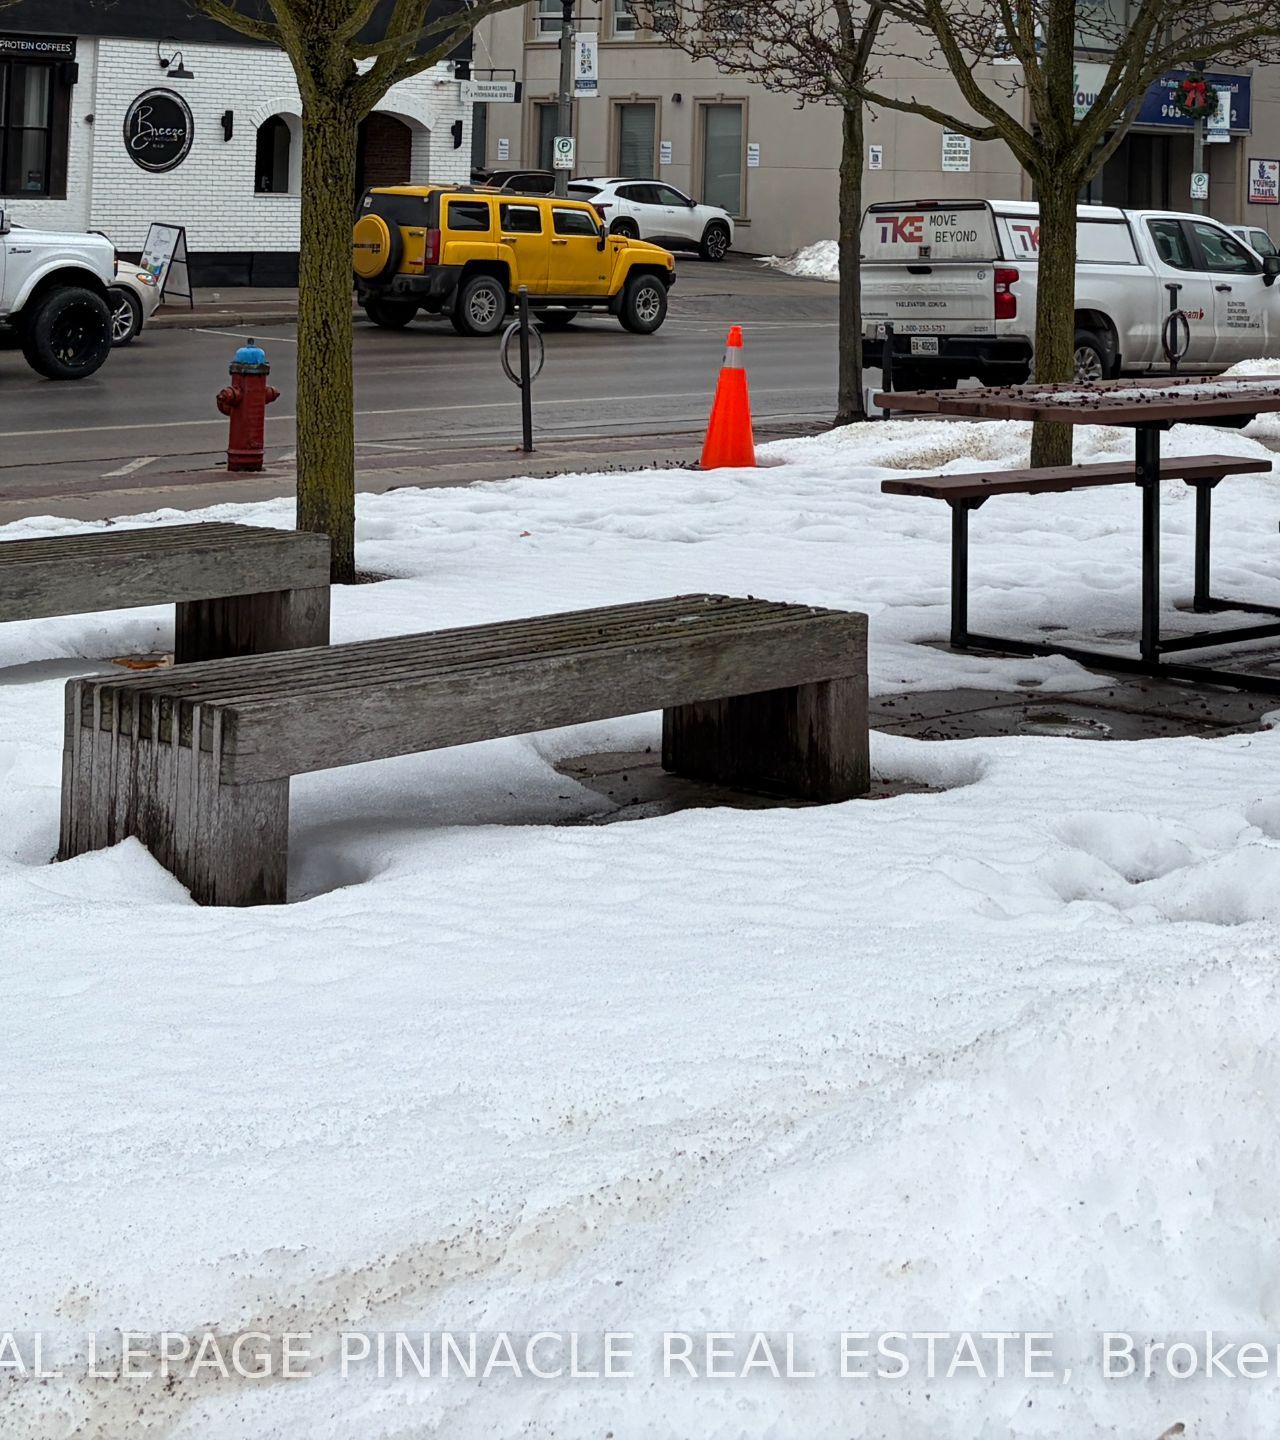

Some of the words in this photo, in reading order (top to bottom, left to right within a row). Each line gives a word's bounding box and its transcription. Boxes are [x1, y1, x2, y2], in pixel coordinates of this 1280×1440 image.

[0, 40, 35, 50] PROTEIN
[35, 42, 72, 53] COFFEES
[875, 216, 925, 244] TKE
[929, 214, 958, 227] MOVE
[935, 230, 978, 243] BEYOND
